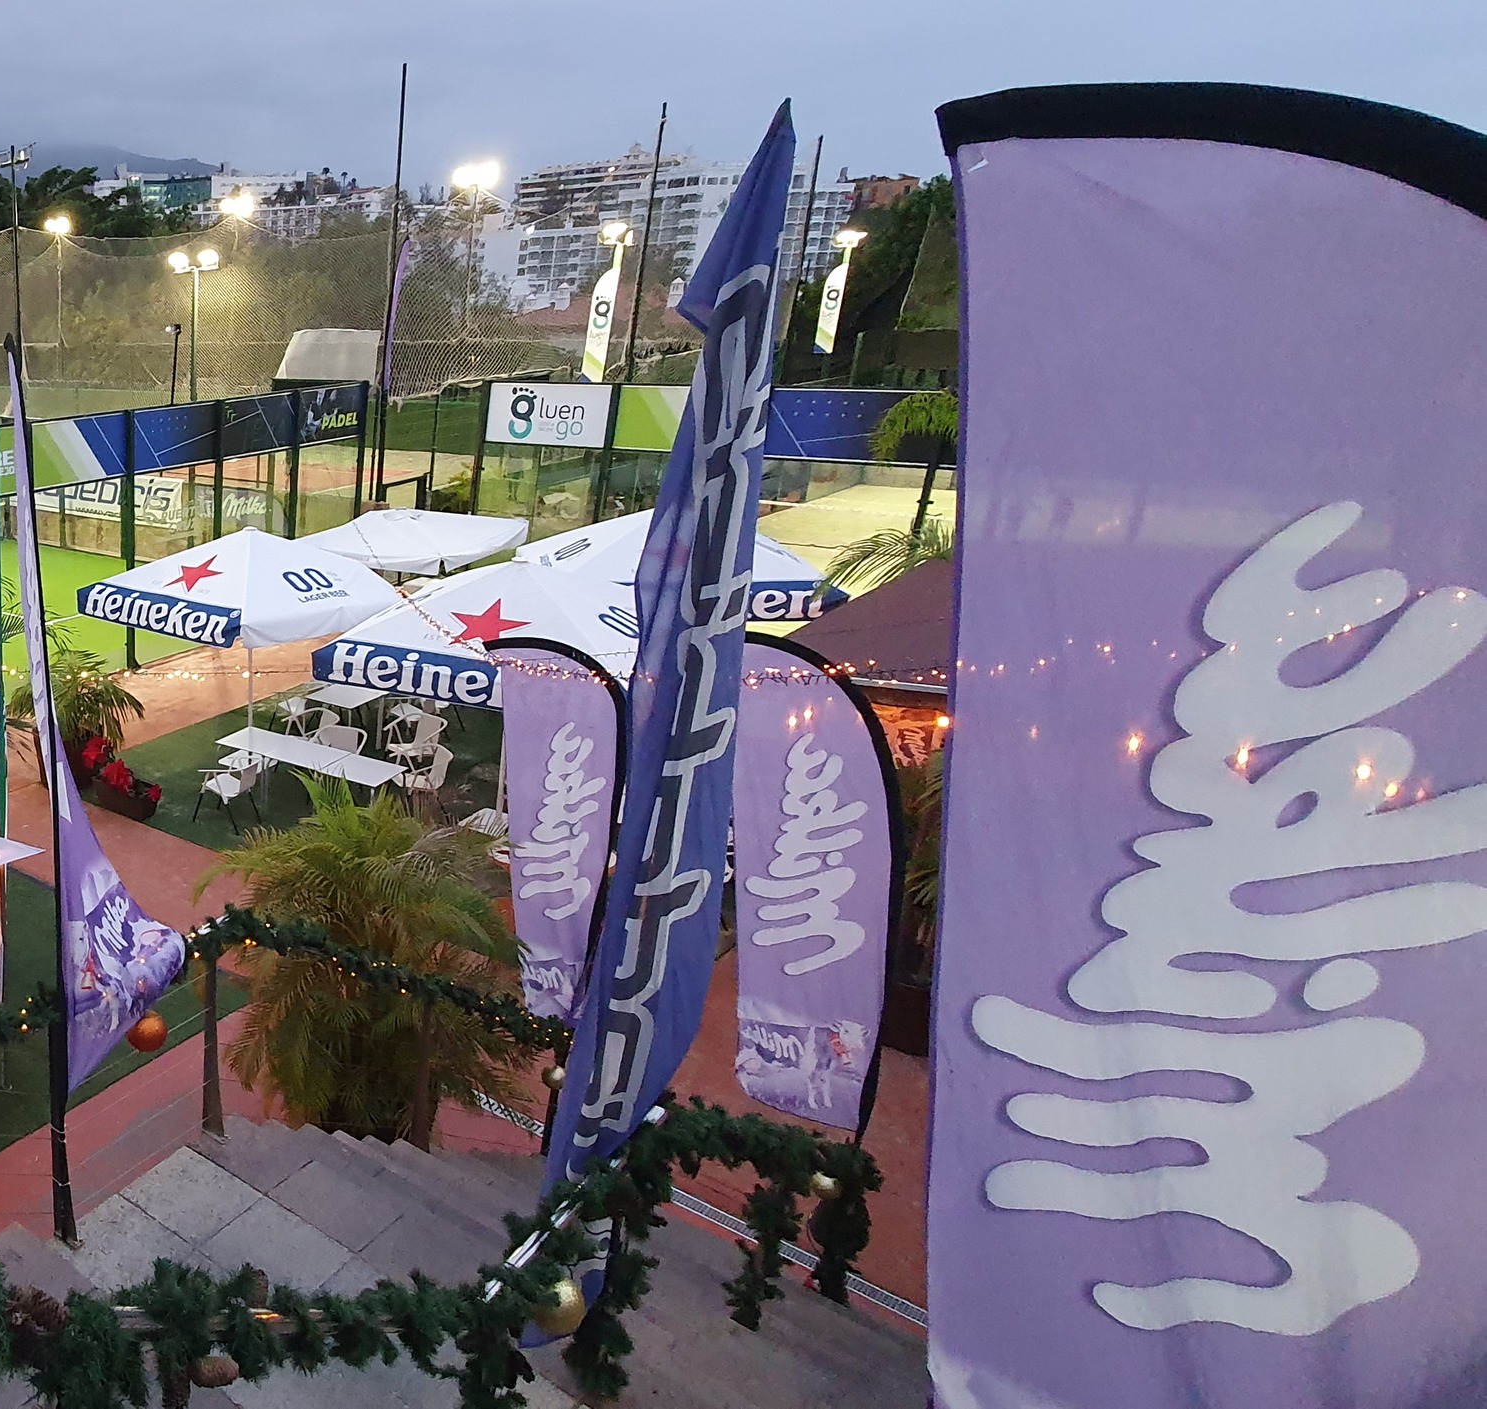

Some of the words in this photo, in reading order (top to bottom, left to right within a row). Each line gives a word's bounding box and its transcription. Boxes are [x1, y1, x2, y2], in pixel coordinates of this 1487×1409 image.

[321, 412, 359, 431] PADEL
[555, 420, 584, 441] go
[282, 567, 334, 593] 0.0
[298, 591, 330, 604] LAGER
[84, 583, 232, 646] Heineken
[328, 642, 503, 708] Heine
[94, 895, 130, 956] Milka
